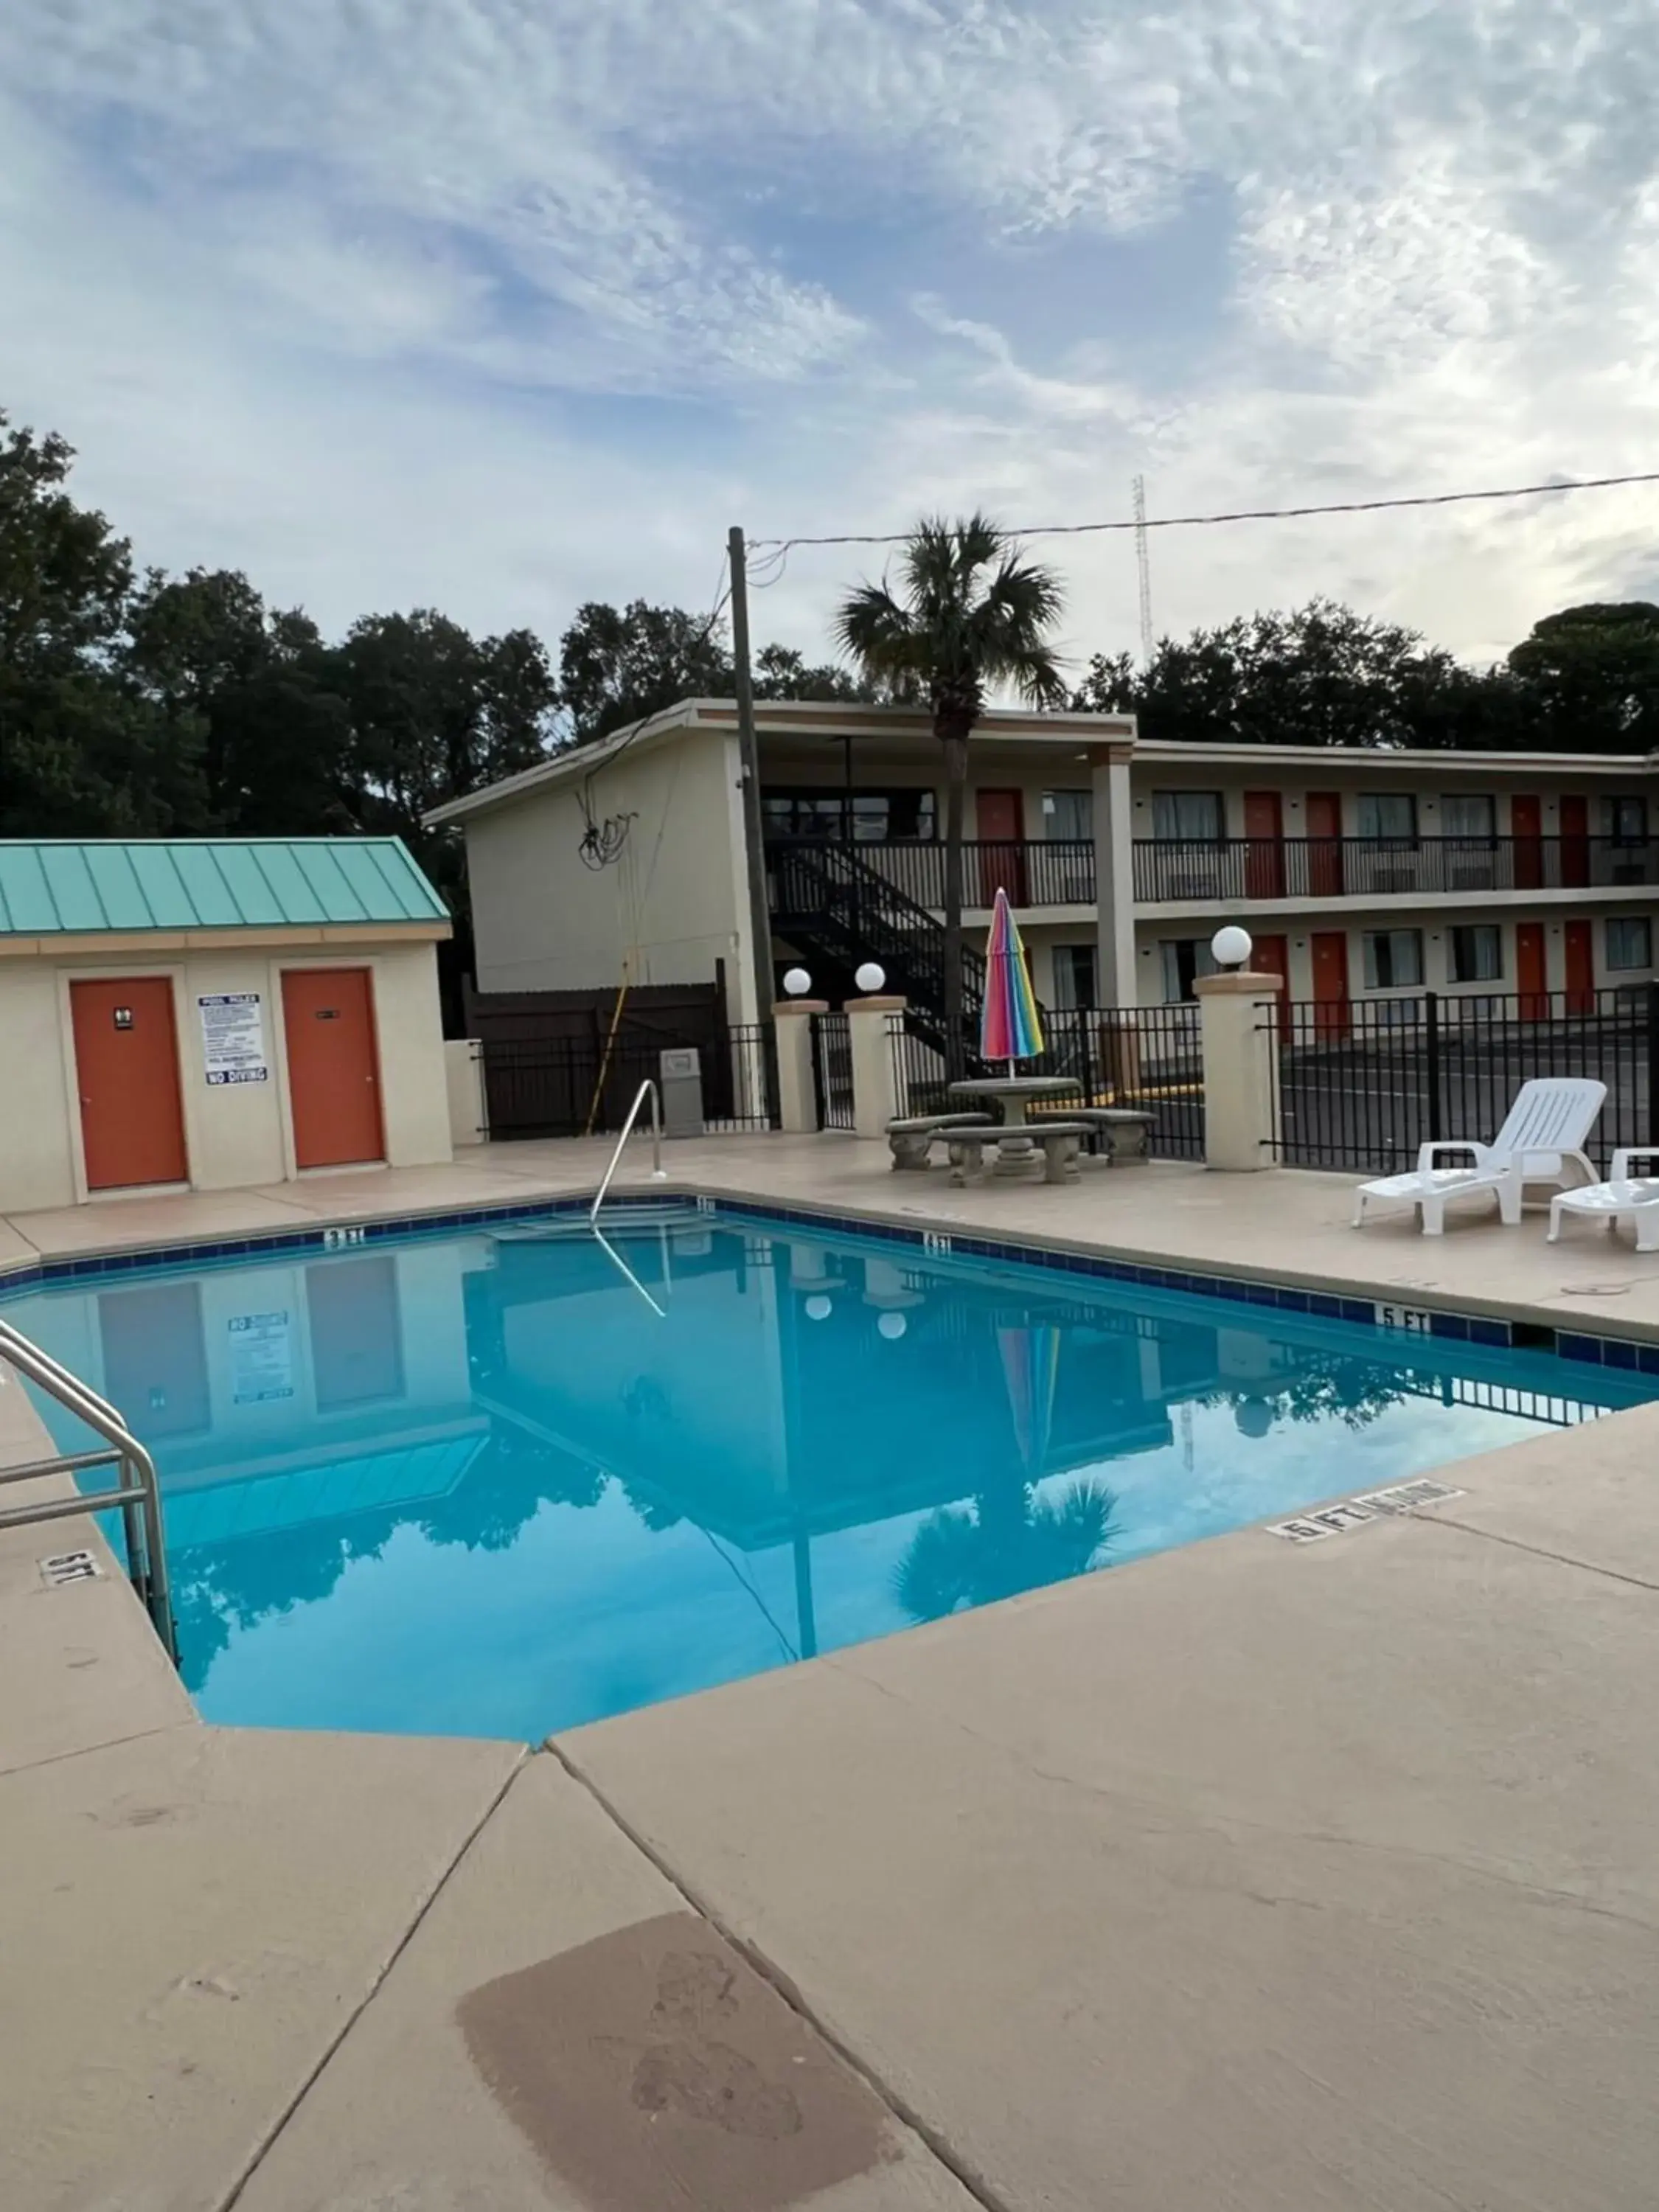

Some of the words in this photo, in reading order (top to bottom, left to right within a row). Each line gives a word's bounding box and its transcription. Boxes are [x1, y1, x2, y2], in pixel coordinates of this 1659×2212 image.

[209, 1072, 225, 1083] NO
[229, 1068, 265, 1082] DIVING
[1383, 1307, 1394, 1327] 5
[1404, 1310, 1427, 1332] FT
[1281, 1522, 1326, 1538] 5
[1315, 1507, 1371, 1528] FT
